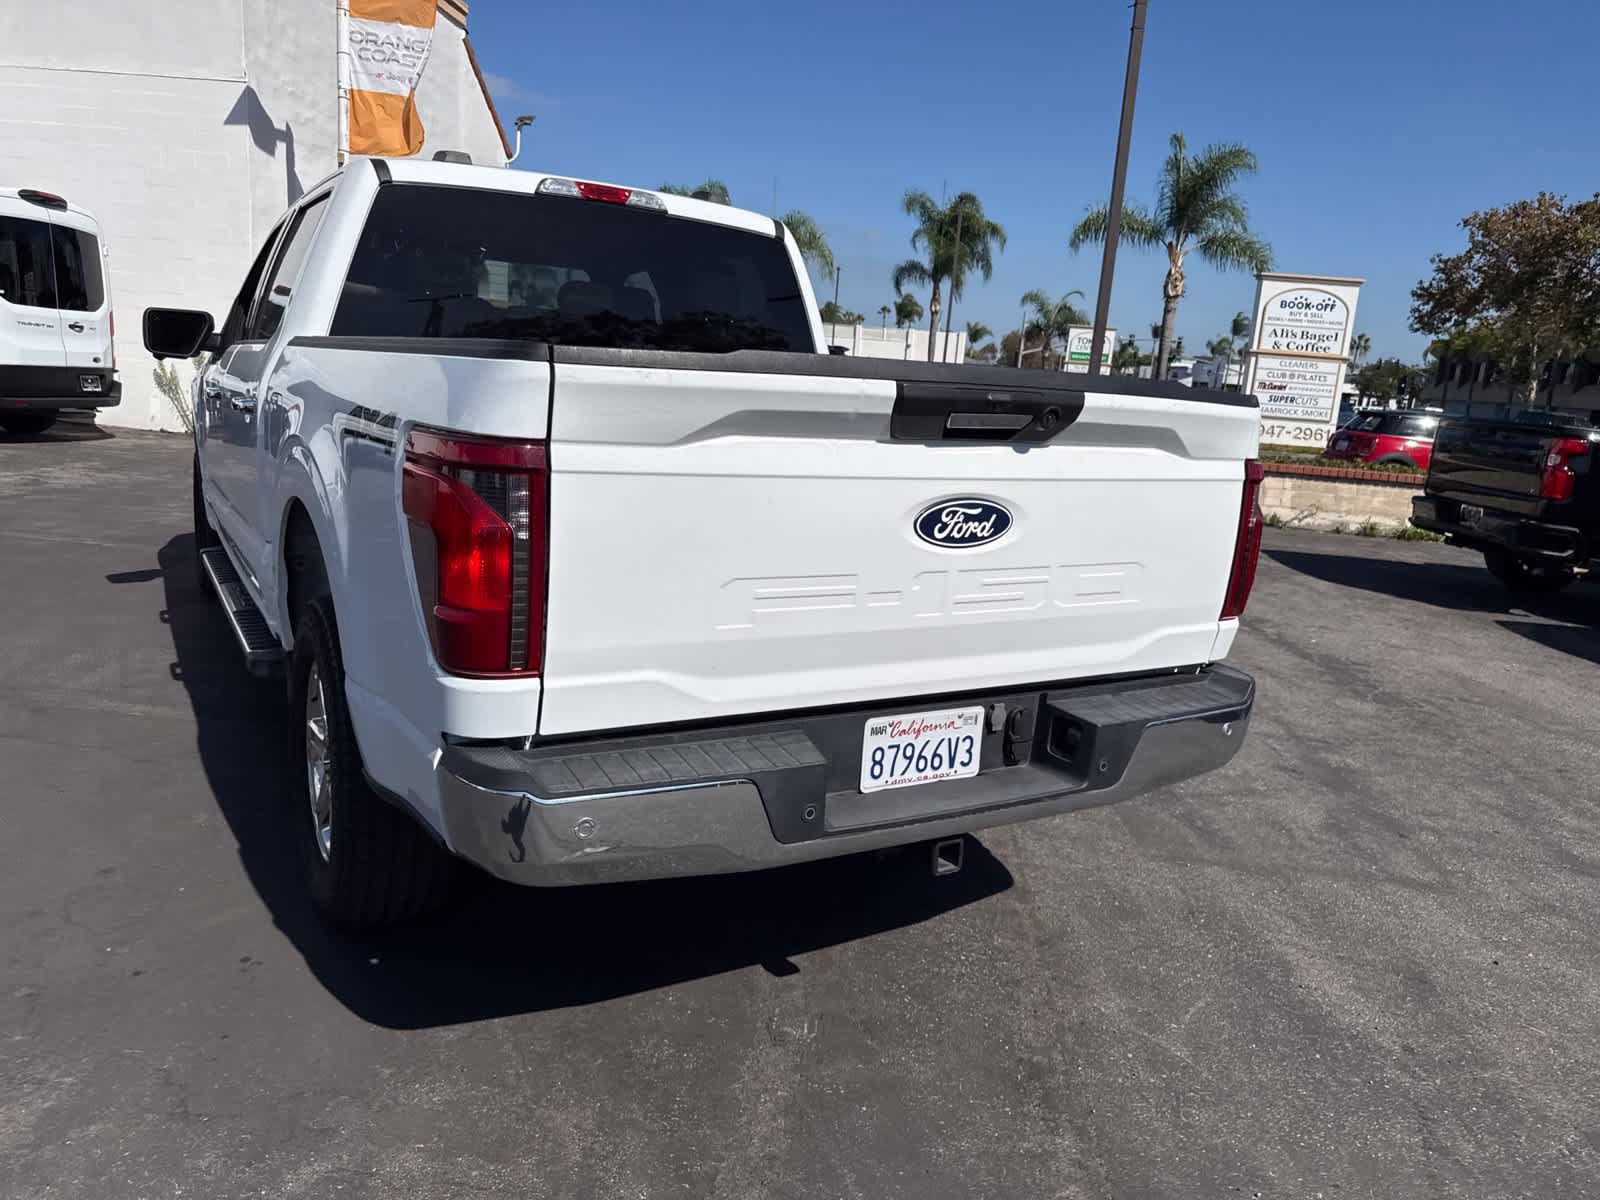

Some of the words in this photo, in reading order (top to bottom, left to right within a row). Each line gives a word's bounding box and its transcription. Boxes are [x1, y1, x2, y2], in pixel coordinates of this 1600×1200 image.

[349, 30, 426, 53] ORANG
[1300, 330, 1339, 343] Bagel
[1272, 340, 1282, 350] &
[1286, 341, 1331, 353] Coffee
[1280, 360, 1319, 370] CLEANERS
[1266, 371, 1287, 379] CLUB
[1297, 373, 1328, 383] PILATES
[1301, 409, 1329, 418] SMOKE
[870, 725, 888, 737] MAR
[890, 719, 962, 739] California
[870, 735, 975, 780] 87966V3
